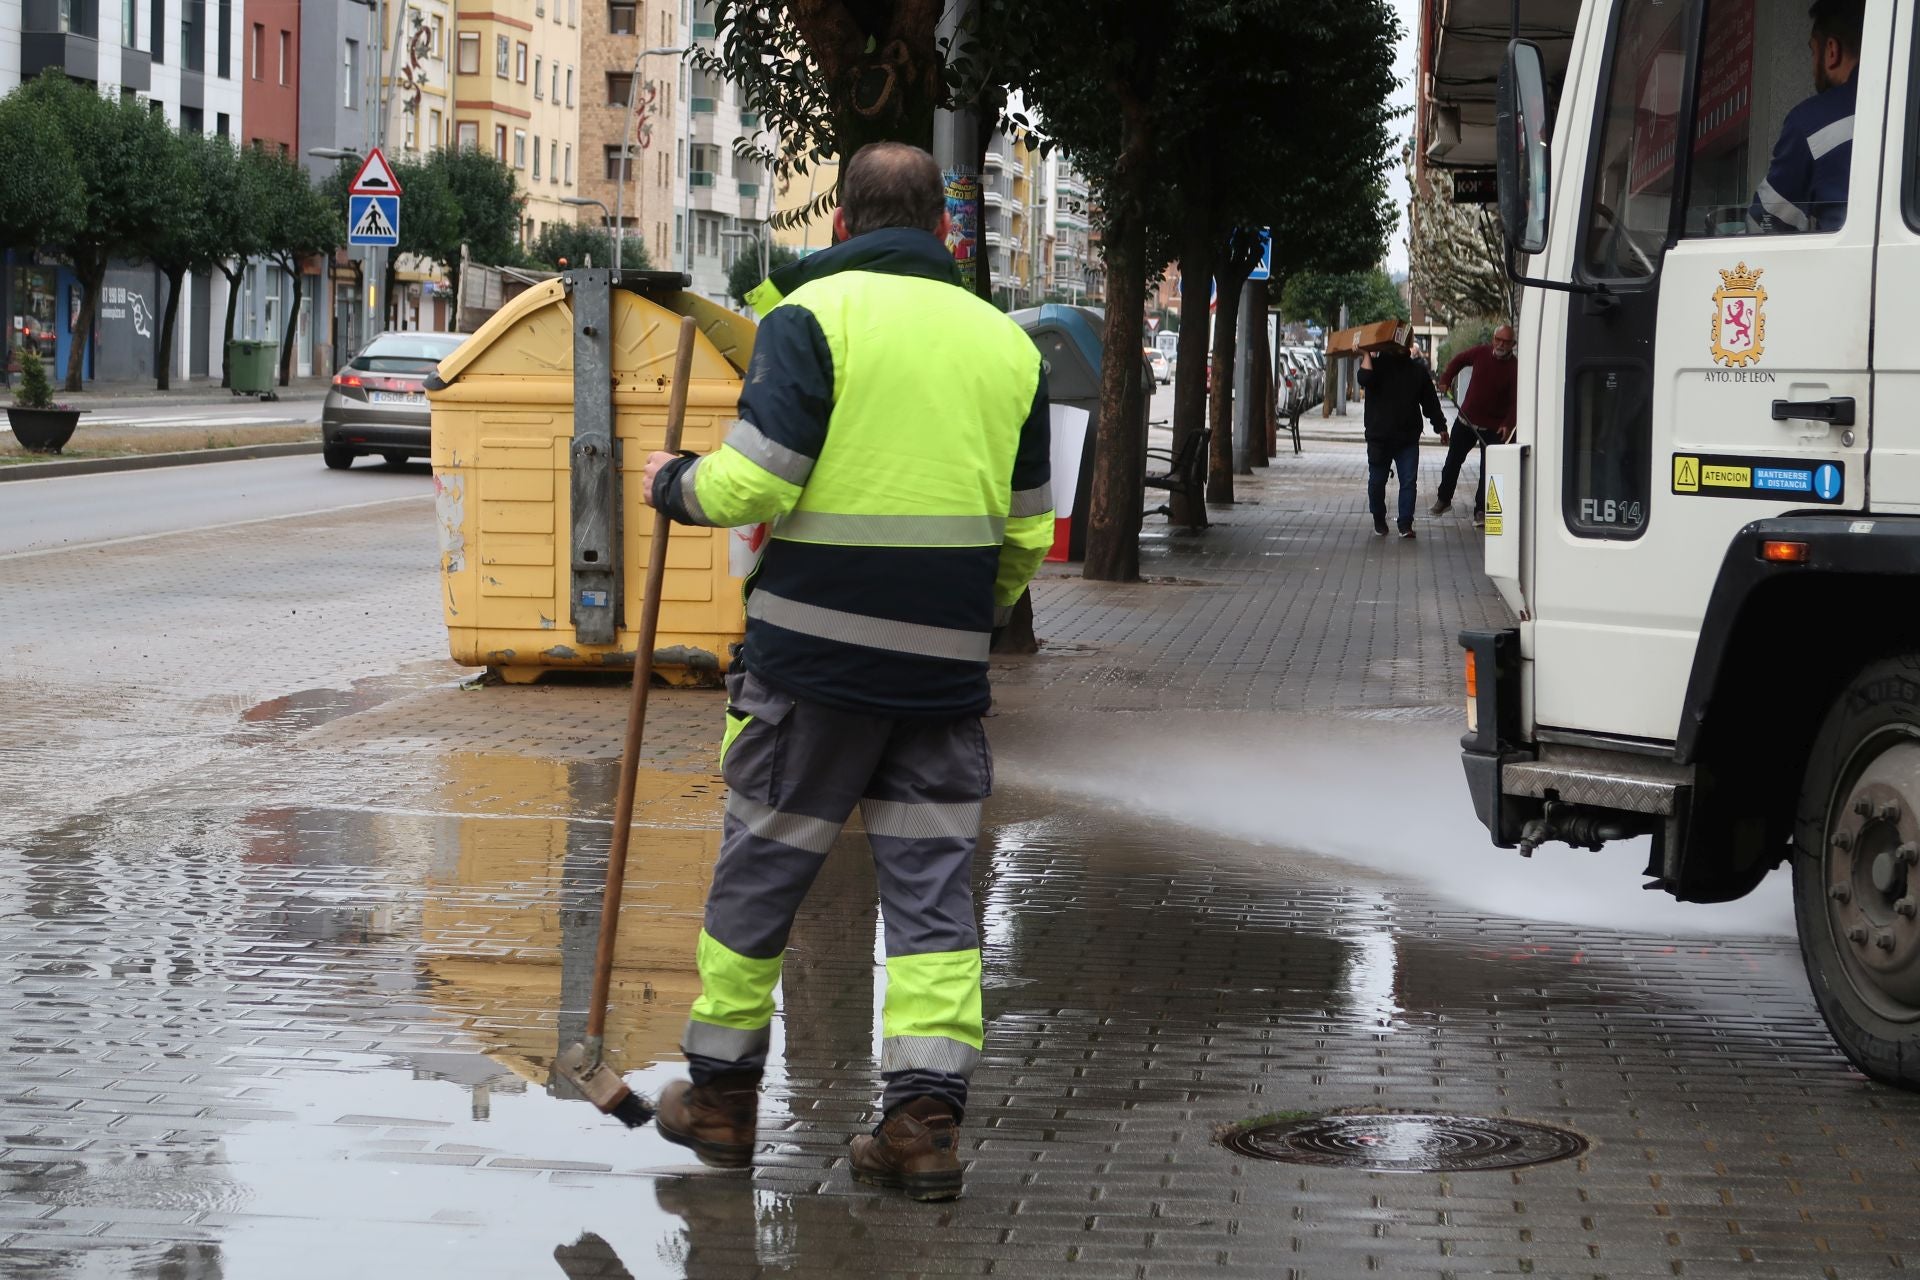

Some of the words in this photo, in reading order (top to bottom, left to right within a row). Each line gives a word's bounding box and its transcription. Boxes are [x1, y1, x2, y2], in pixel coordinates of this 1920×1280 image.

[1704, 371, 1732, 383] AYTO.
[1735, 371, 1747, 383] DE
[1705, 472, 1748, 482] ATENCION
[1758, 470, 1807, 480] MANTENERSE
[1768, 480, 1807, 489] DISTANCIA
[1581, 498, 1617, 522] FL6
[1618, 500, 1642, 524] 14
